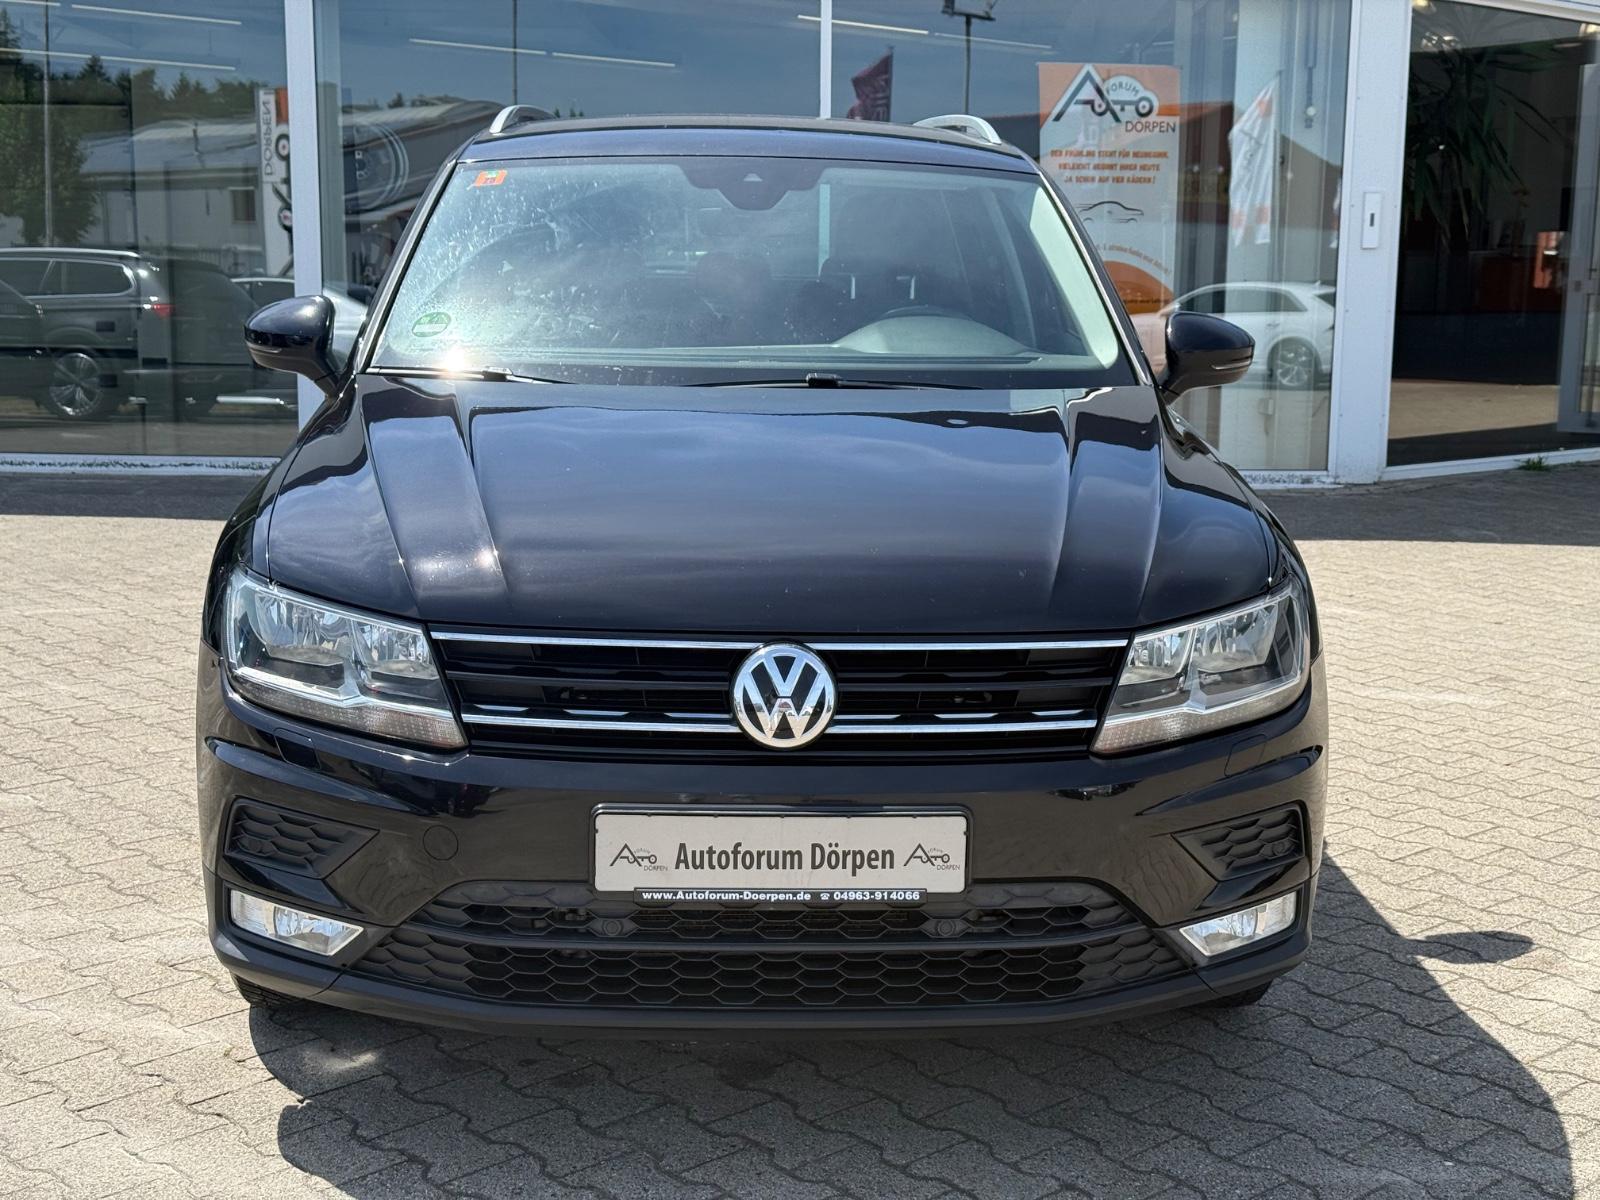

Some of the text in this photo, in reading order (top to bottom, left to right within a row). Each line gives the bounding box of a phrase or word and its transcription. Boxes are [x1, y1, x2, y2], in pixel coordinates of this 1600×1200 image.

[675, 842, 895, 877] Autoforum Dörpen
[642, 890, 920, 902] www.Autoforum-Doerpen.de 04963-914066
